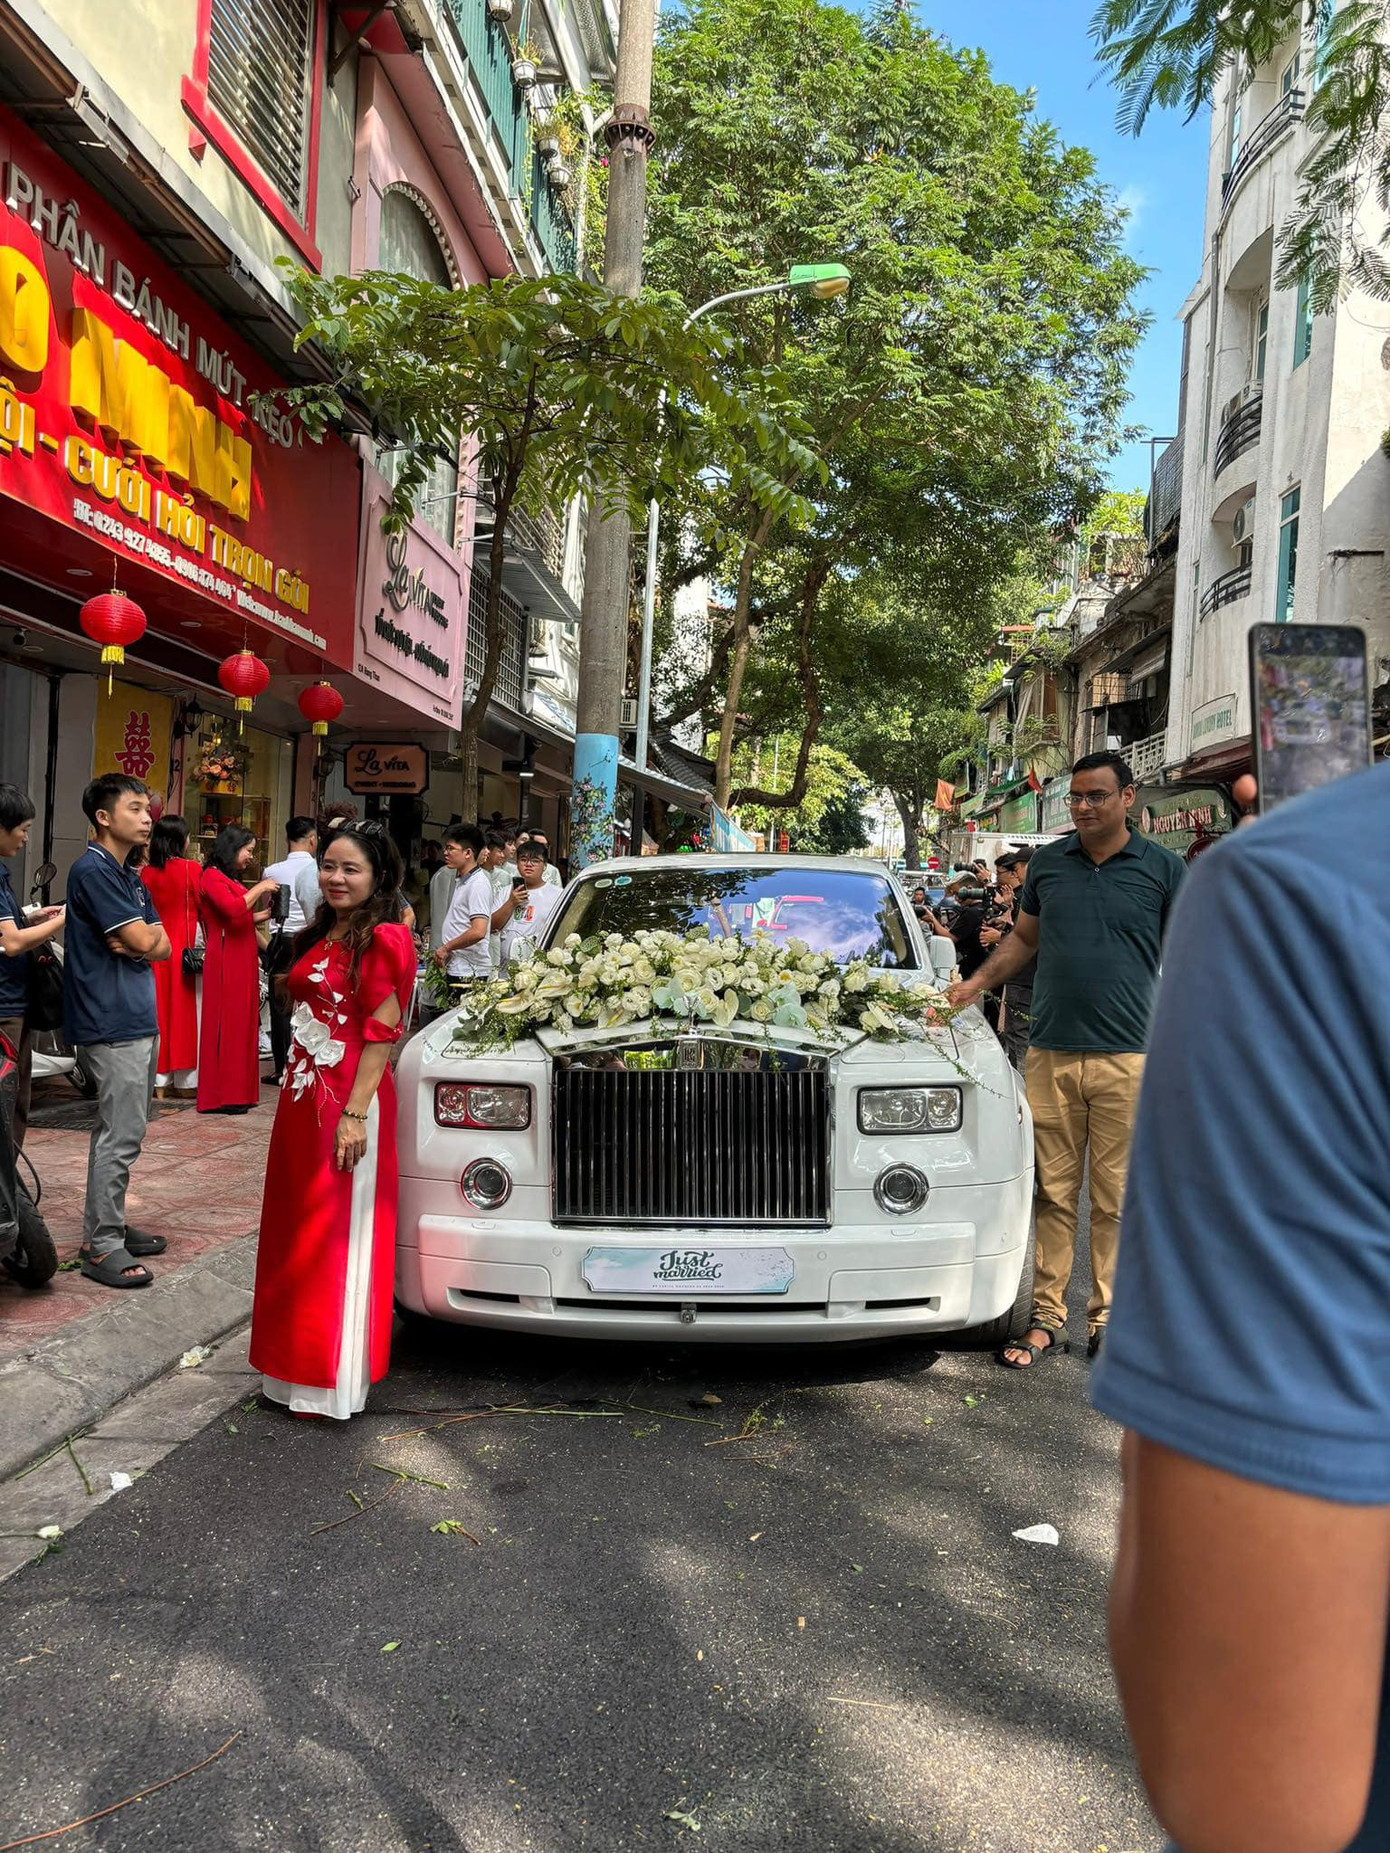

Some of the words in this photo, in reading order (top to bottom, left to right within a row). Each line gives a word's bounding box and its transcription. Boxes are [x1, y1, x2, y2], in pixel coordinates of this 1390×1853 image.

[6, 162, 105, 286] PHÂN
[113, 260, 190, 360] BÁNH
[65, 435, 151, 522] CƯỚI
[156, 490, 206, 555] HỎI
[209, 524, 274, 594] TRỌN
[275, 567, 310, 615] GÓI
[354, 748, 382, 776] La
[653, 1263, 724, 1279] married
[659, 1250, 715, 1271] Just
